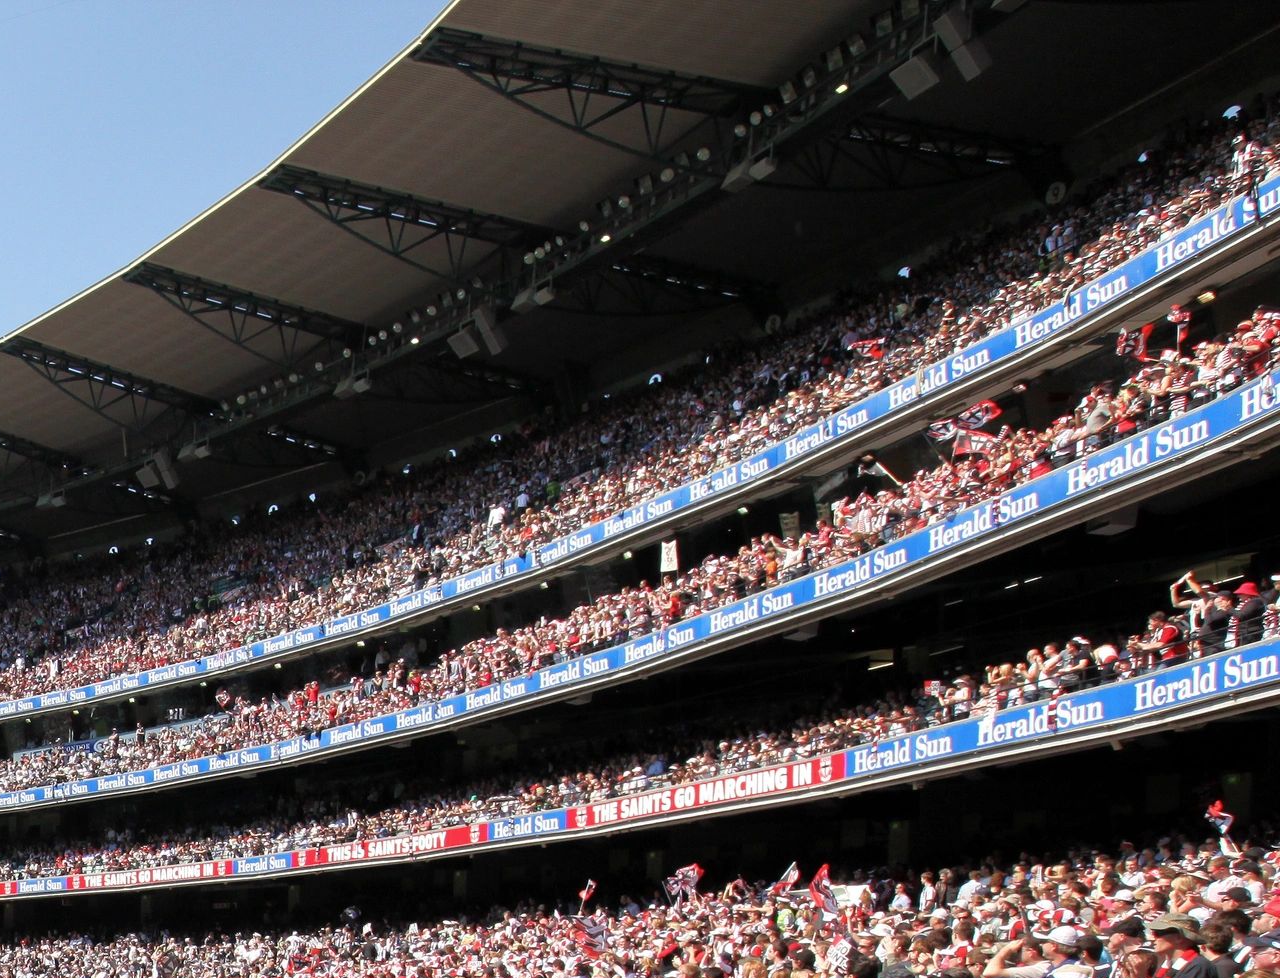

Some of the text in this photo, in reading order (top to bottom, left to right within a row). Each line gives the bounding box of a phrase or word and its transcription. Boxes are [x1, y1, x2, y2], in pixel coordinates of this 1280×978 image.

[1155, 202, 1235, 274] Herald
[1014, 272, 1127, 348] Herald Sun
[952, 346, 990, 379] Sun
[837, 406, 868, 435] Sun
[1066, 414, 1208, 496] Herald Sun
[740, 455, 769, 481] Sun
[604, 498, 672, 538] Herald Sun
[929, 490, 1038, 553] Herald Sun
[570, 532, 591, 552] Sun
[456, 568, 491, 594] Herald
[814, 545, 907, 597] Herald Sun
[325, 612, 379, 637] Herald Sun
[710, 590, 793, 634] Herald Sun
[263, 632, 313, 654] Herald Sun
[668, 626, 694, 648] Sun
[178, 664, 196, 676] Sun
[540, 656, 609, 688] Herald Sun
[1134, 652, 1278, 711] Herald Sun
[70, 690, 86, 700] Sun
[122, 678, 139, 689] Sun
[466, 682, 525, 710] Herald Sun
[18, 700, 33, 711] Sun
[396, 706, 432, 728] Herald
[1056, 698, 1103, 729] Sun
[301, 737, 320, 752] Sun
[330, 721, 384, 744] Herald Sun
[209, 750, 259, 770] Herald Sun
[854, 733, 952, 774] Herald Sun
[97, 772, 145, 790] Herald Sun
[153, 762, 198, 780] Herald Sun
[71, 782, 88, 794] Sun
[593, 761, 812, 824] THE SAINTS GO MARCHING IN
[534, 815, 559, 833] Sun
[327, 844, 351, 861] THIS
[368, 837, 410, 857] SAINTS
[412, 831, 446, 851] FOOTY
[85, 863, 213, 887] THE SAINTS GO MARCHING IN
[237, 855, 286, 872] Herald Sun
[46, 879, 62, 890] Sun
